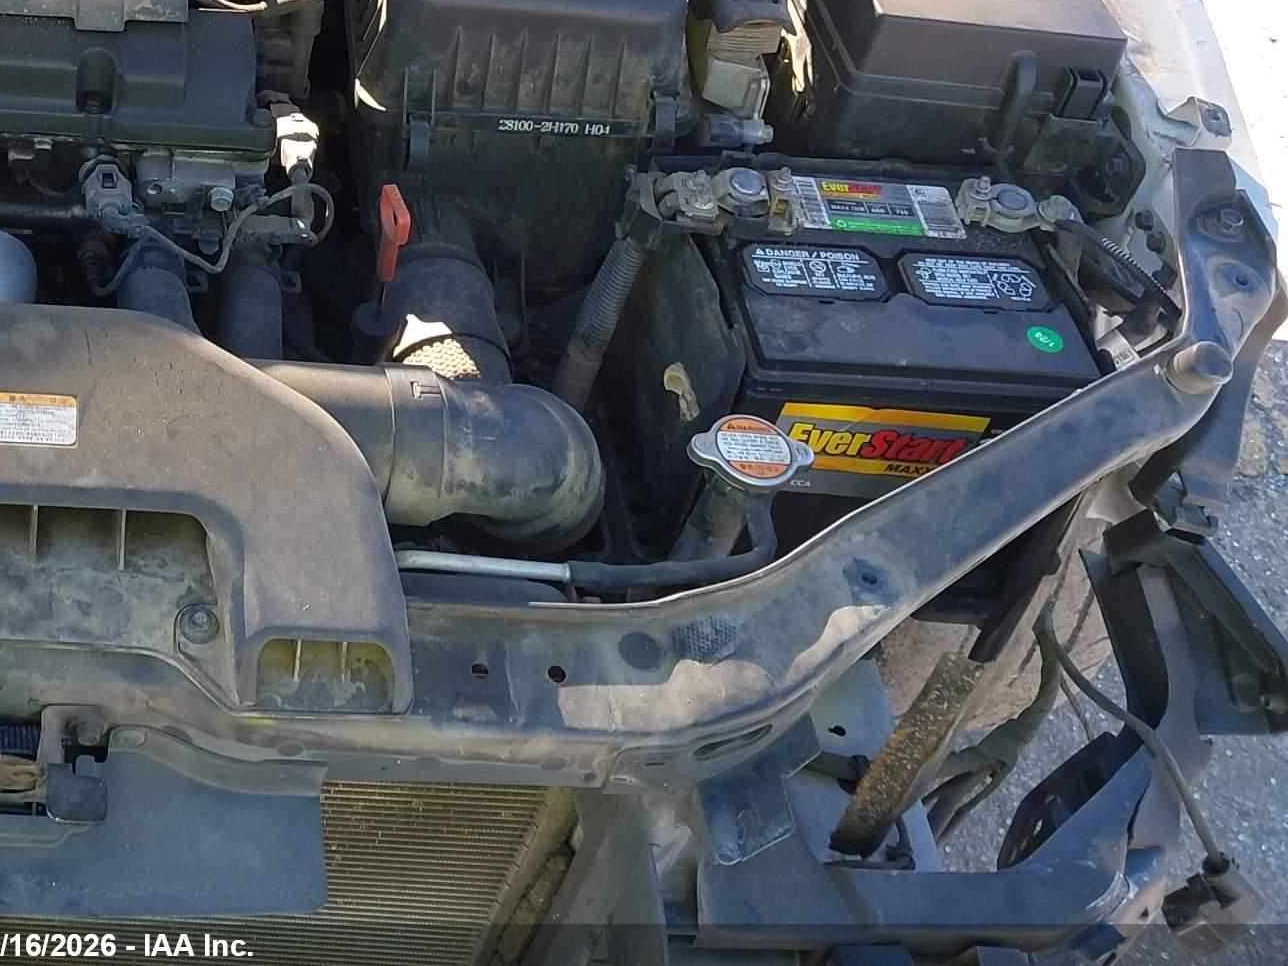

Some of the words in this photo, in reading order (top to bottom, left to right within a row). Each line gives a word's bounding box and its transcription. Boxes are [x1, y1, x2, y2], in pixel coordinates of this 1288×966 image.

[765, 248, 810, 258] DANGER
[820, 251, 860, 261] POISON
[788, 422, 969, 465] EverStart
[789, 479, 811, 487] CCA
